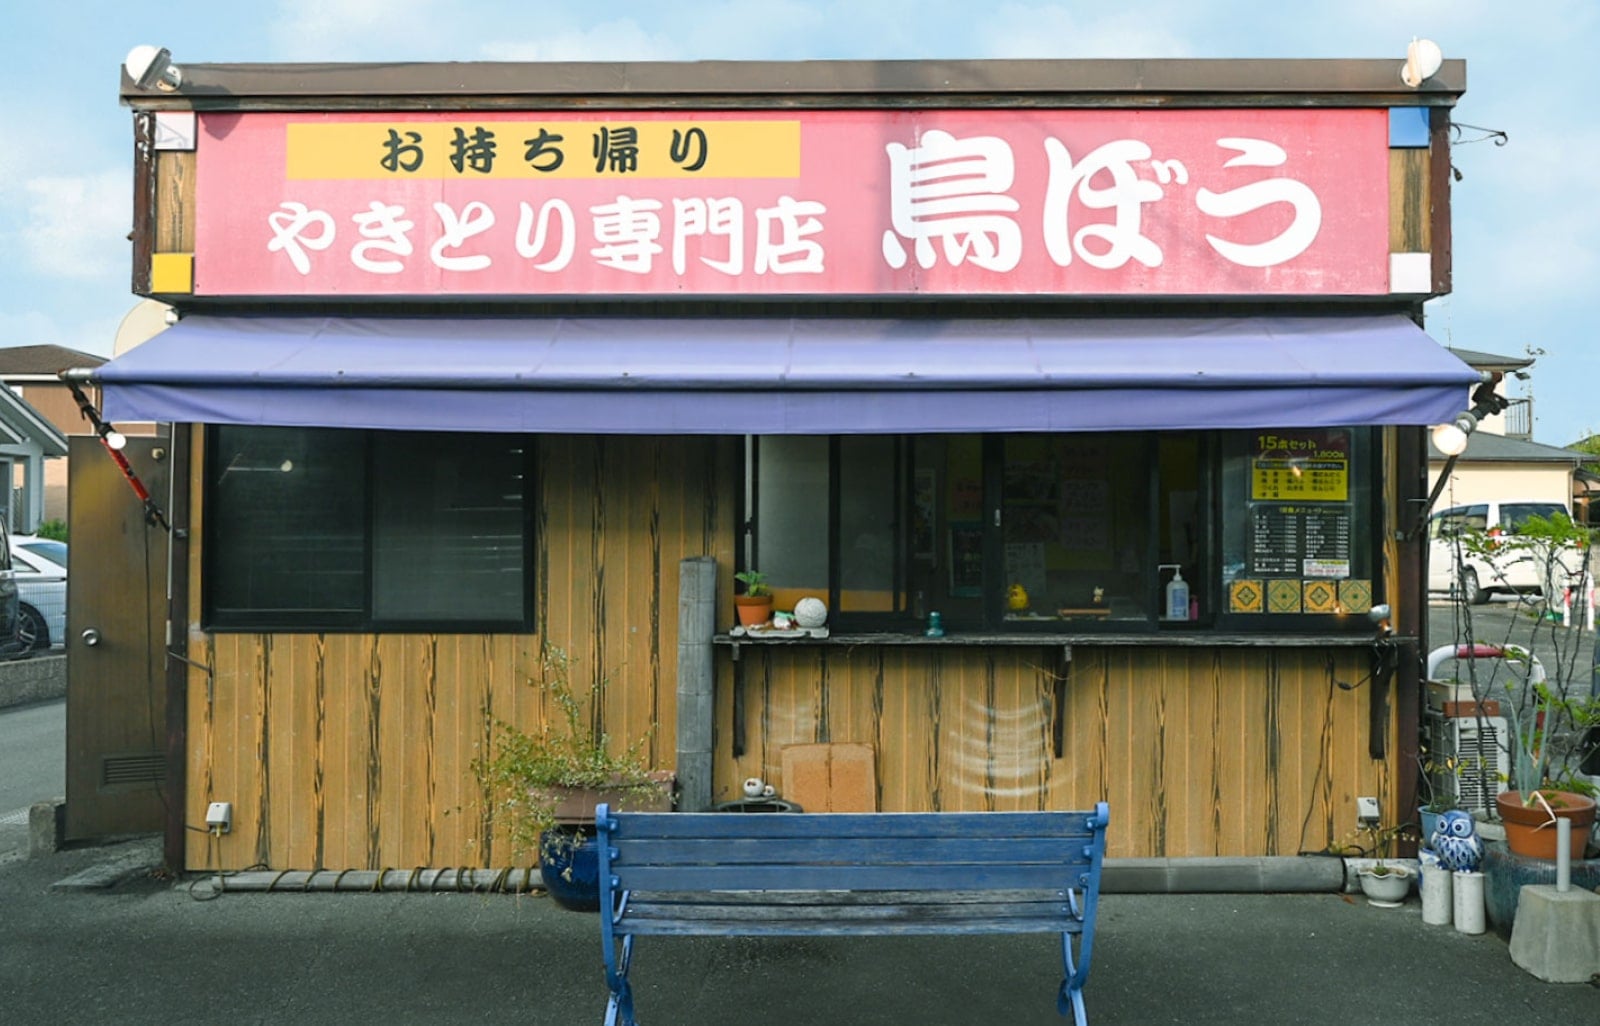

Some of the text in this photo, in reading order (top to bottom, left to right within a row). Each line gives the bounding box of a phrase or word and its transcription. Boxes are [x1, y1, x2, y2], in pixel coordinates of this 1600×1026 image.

[380, 127, 708, 173] お持ち帰り
[267, 195, 826, 276] やきとり専門店
[882, 130, 1322, 274] 鳥ぼう
